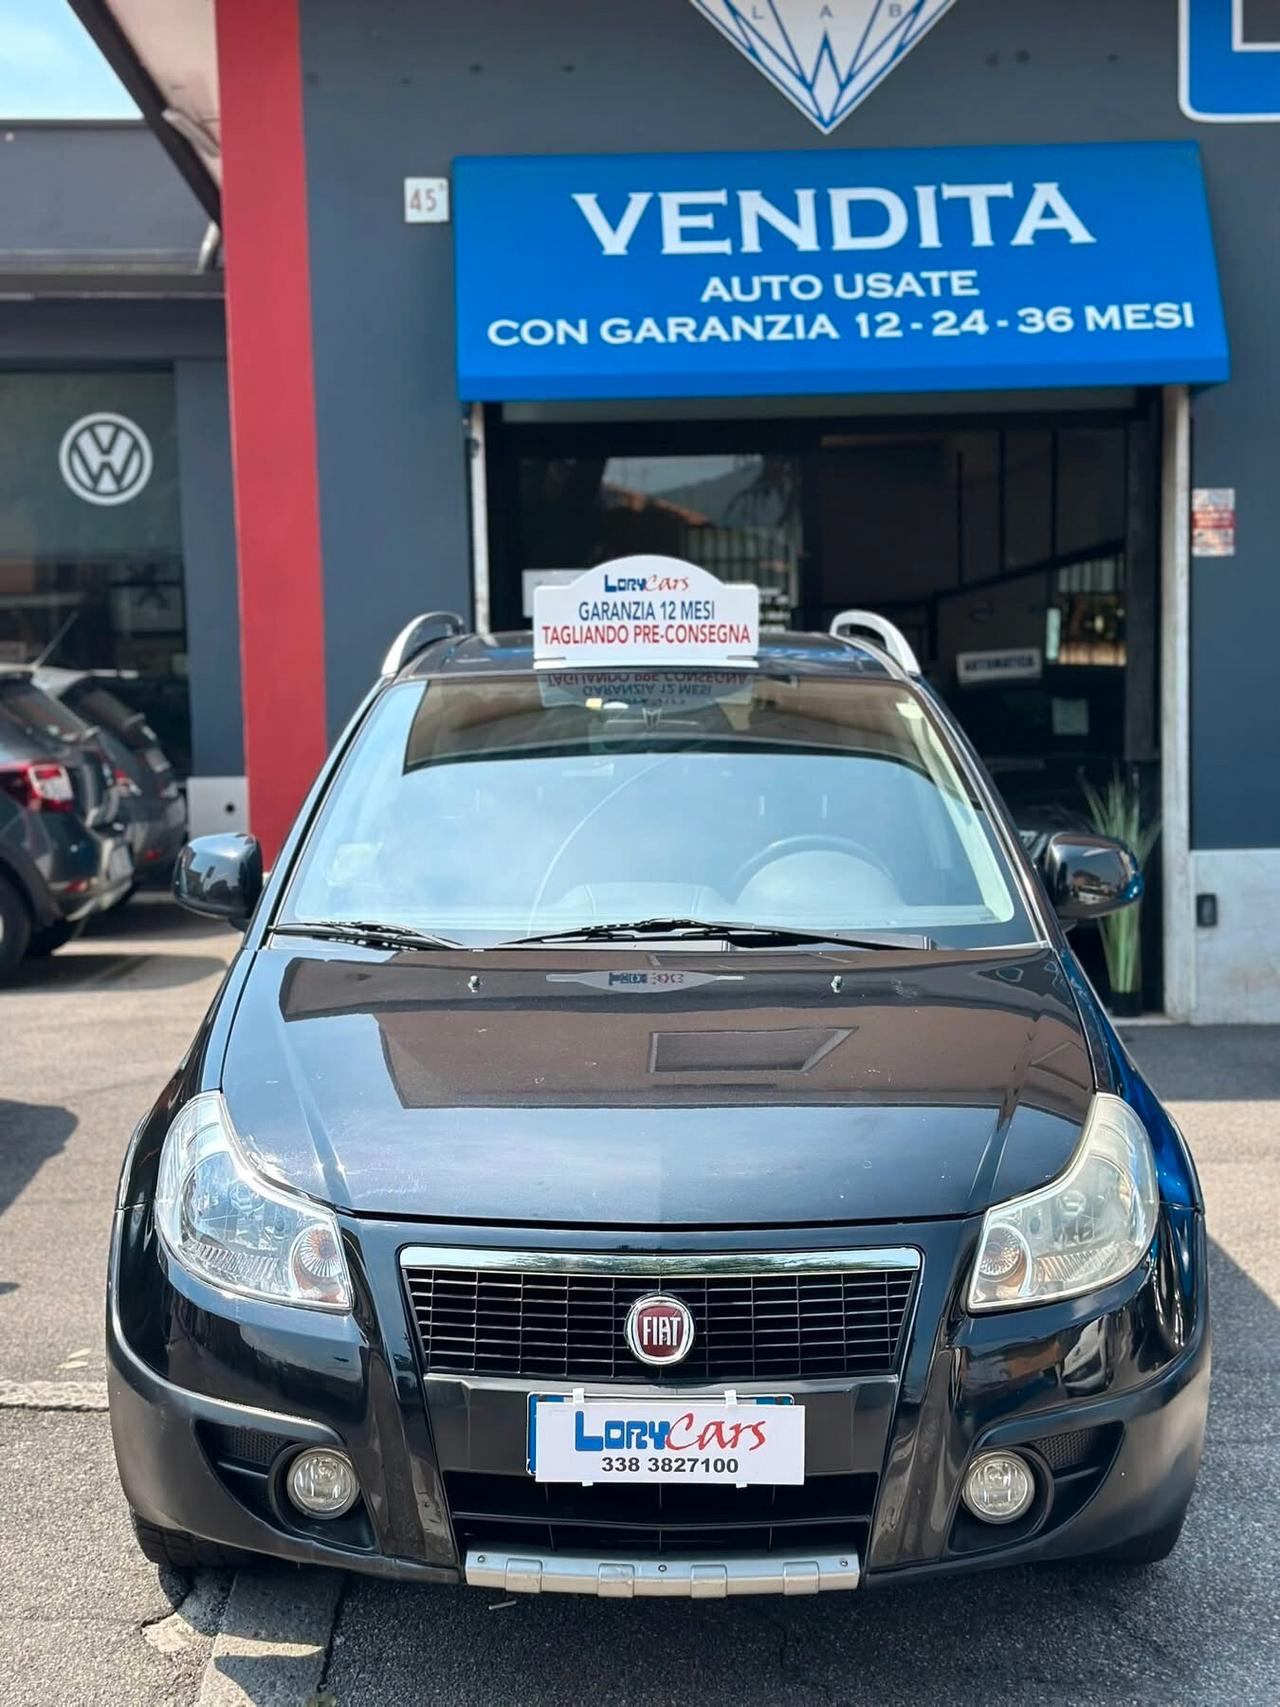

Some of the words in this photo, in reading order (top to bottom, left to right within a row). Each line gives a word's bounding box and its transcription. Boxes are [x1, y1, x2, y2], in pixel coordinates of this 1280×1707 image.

[574, 183, 1094, 255] VENDITA
[702, 274, 822, 303] AUTO
[834, 270, 980, 299] USATE
[487, 318, 588, 347] CON
[600, 314, 839, 344] GARANZIA
[856, 312, 903, 338] 12
[932, 310, 988, 336] 24
[1018, 306, 1074, 333] 36
[1085, 303, 1194, 331] MESI
[578, 601, 656, 622] GARANZIA
[660, 601, 676, 621] 12
[680, 601, 715, 620] MESI
[542, 625, 629, 645] TAGLIANDO
[632, 624, 751, 644] PRE-CONSEGNA
[642, 1315, 681, 1346] FIAT
[601, 1456, 640, 1473] 338
[647, 1457, 739, 1474] 3827100
